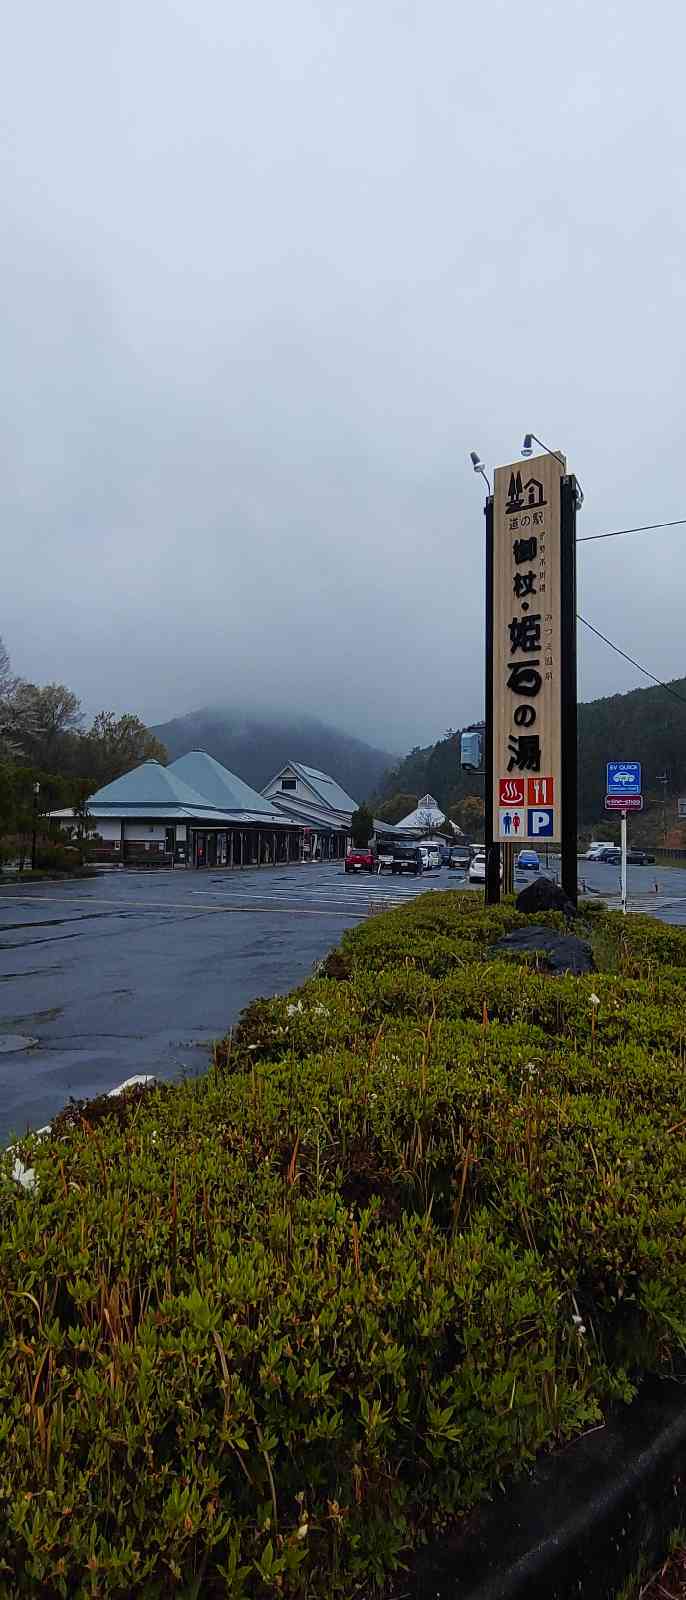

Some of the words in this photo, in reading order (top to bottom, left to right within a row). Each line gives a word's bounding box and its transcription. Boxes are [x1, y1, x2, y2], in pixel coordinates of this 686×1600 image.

[510, 511, 544, 530] 道の駅
[507, 536, 543, 772] 御杖・姫石の湯
[532, 812, 550, 834] P
